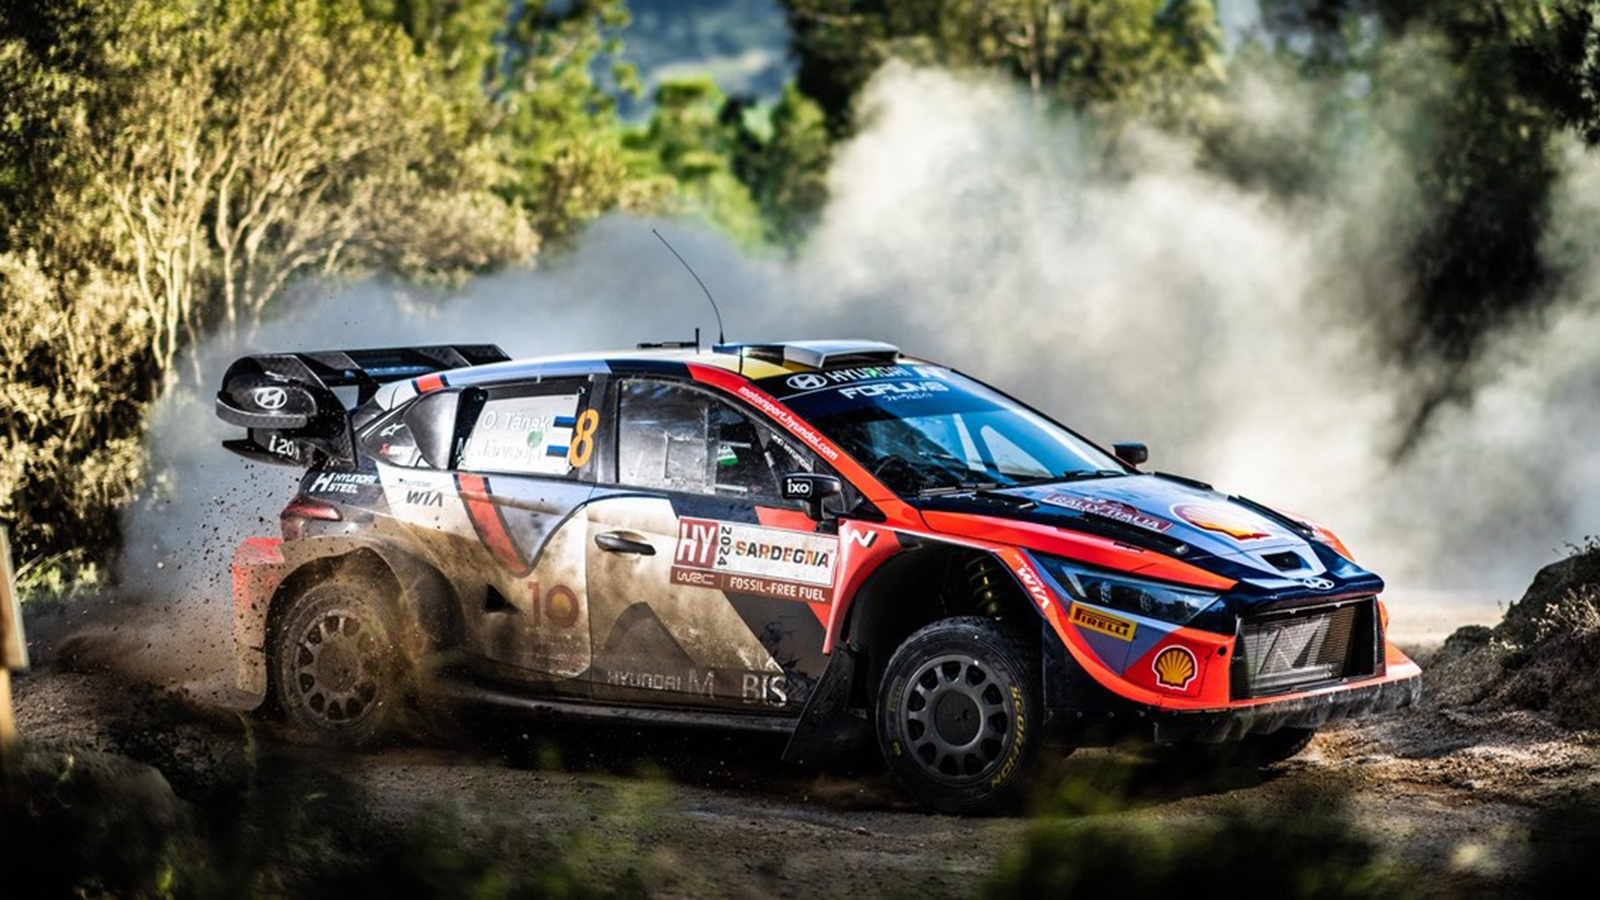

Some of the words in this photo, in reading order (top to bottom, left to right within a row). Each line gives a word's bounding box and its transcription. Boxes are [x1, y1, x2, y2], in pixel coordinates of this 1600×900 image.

[738, 385, 839, 461] motorsport.hyundai.com
[569, 409, 599, 467] 8
[327, 483, 359, 493] STEEL
[334, 472, 378, 484] HYUNDAI
[786, 478, 810, 493] ixo
[406, 490, 443, 507] WIA
[1107, 508, 1160, 528] ITALIA
[677, 522, 716, 564] HY
[716, 525, 732, 567] 2024
[735, 540, 829, 568] SARDEGNA
[677, 571, 715, 586] WRC
[729, 576, 797, 598] FOSSIL-FREE
[798, 586, 826, 602] FUEL
[1018, 567, 1050, 610] WIA
[1074, 607, 1130, 637] PIRELLI
[607, 669, 681, 691] HYUNDAI
[990, 683, 1026, 788] SCORPION
